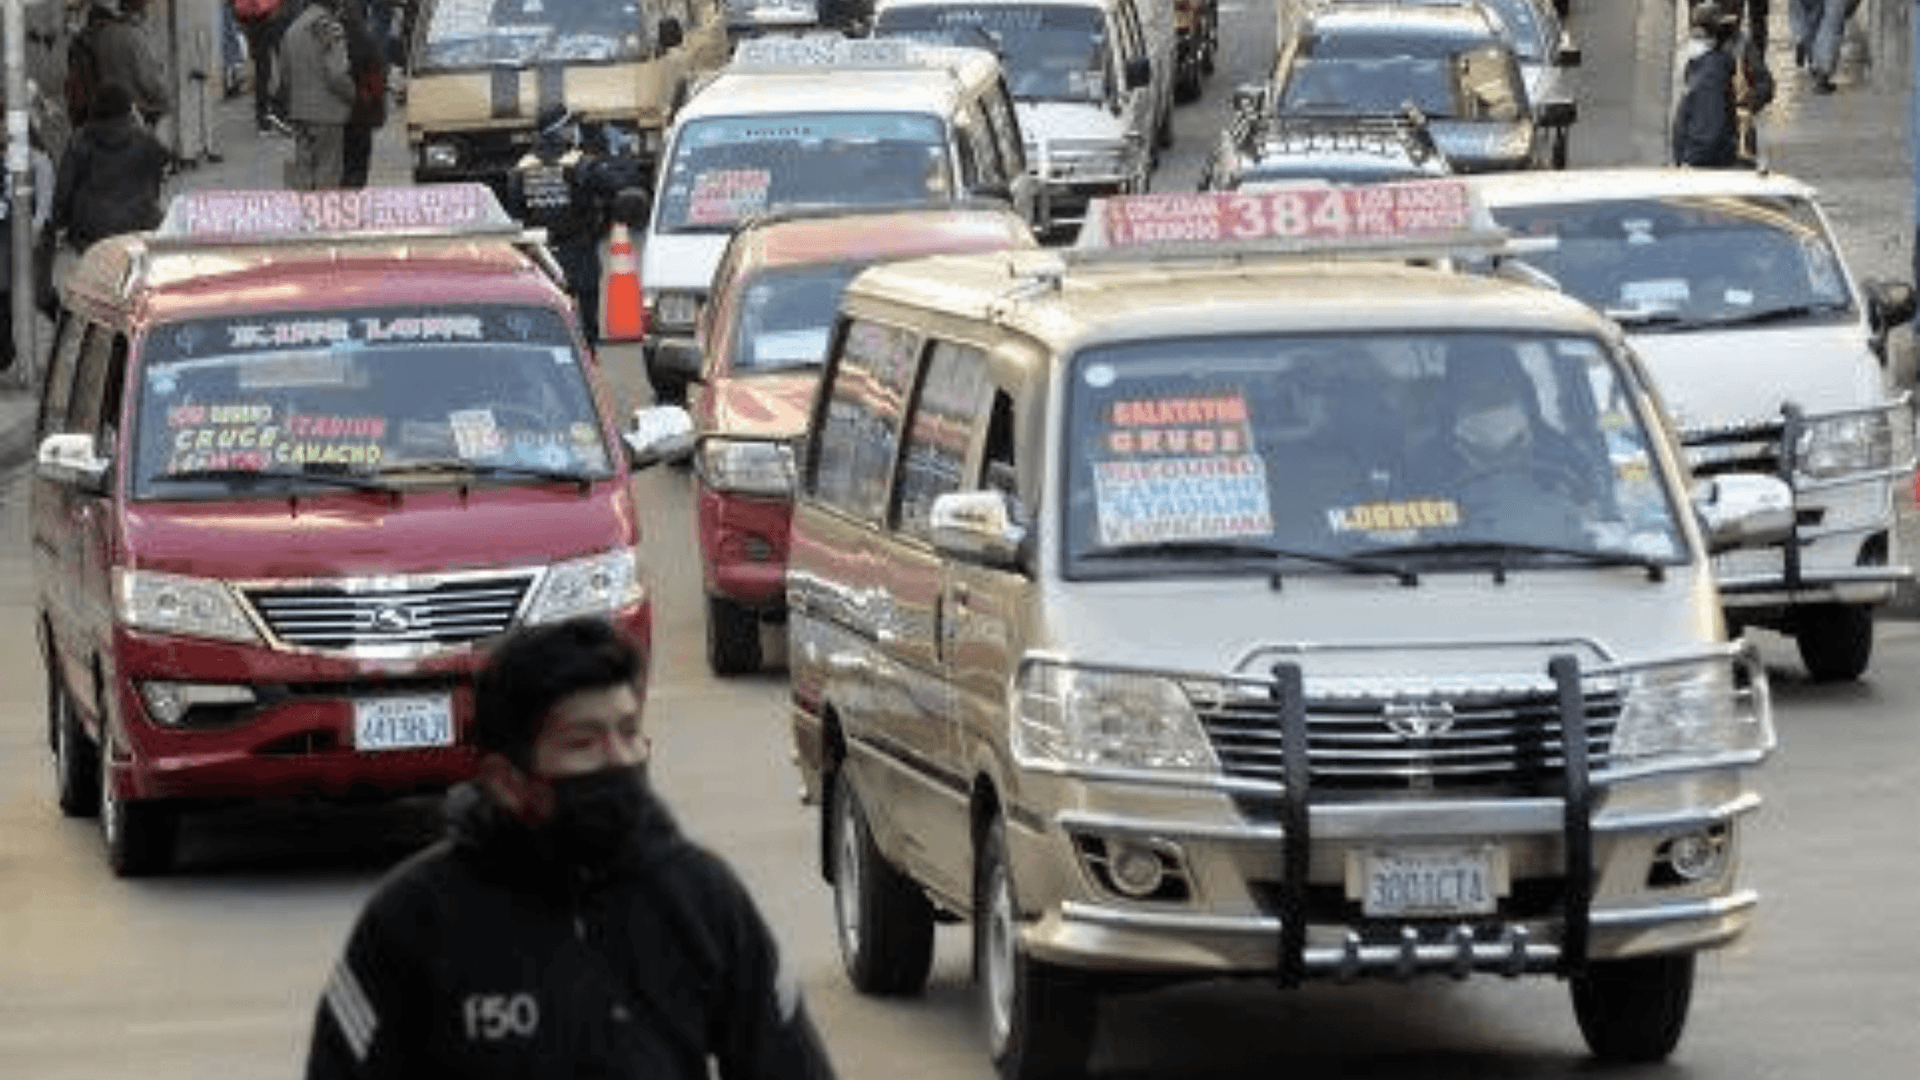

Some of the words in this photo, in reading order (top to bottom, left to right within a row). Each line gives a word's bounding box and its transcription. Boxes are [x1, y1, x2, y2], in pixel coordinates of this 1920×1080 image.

[303, 193, 362, 232] 369
[1232, 188, 1351, 238] 384
[276, 442, 382, 464] CAMACHO
